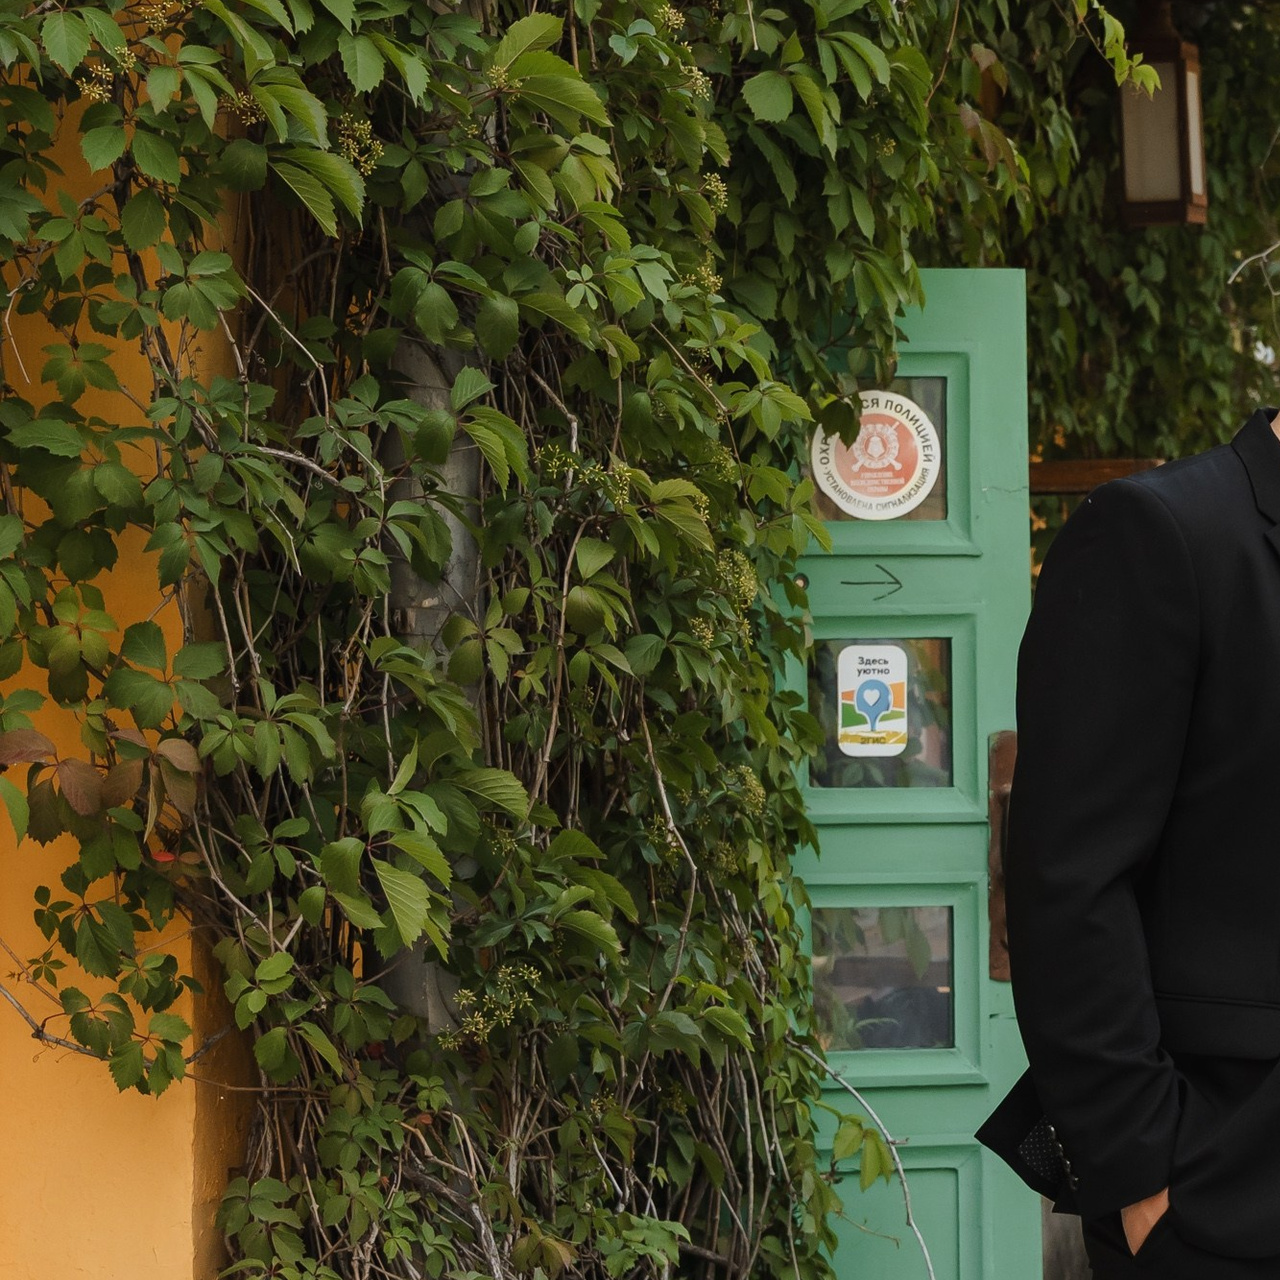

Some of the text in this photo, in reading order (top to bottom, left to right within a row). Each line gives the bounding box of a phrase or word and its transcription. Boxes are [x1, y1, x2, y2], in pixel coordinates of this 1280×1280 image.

[885, 399, 936, 462] ПОЛИЦИЕЙ
[824, 467, 929, 510] УСТАНОВЛЕНА СИГНАЛИЗАЦИЯ
[858, 656, 889, 666] Здесь
[857, 668, 890, 677] уютно
[860, 736, 886, 744] 2ГИС
